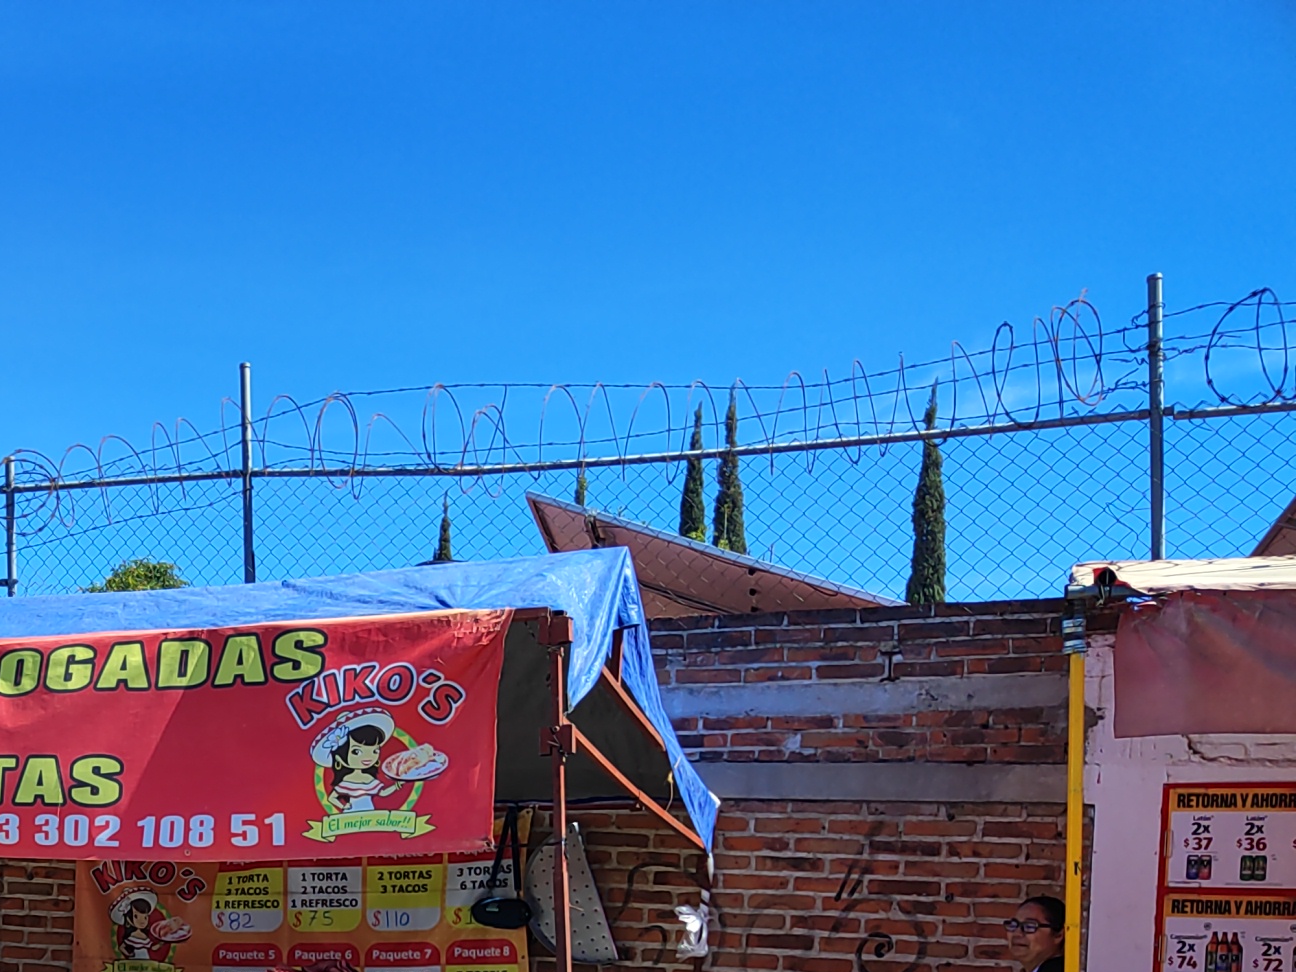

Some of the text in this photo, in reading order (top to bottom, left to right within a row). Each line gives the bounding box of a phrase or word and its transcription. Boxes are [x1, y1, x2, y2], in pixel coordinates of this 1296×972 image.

[1177, 792, 1238, 809] RETORNA
[1240, 792, 1250, 809] Y
[328, 814, 411, 832] El mejor sabor!!
[1191, 822, 1211, 836] 2x
[1244, 822, 1265, 837] 2x
[34, 813, 121, 847] 302
[137, 815, 214, 847] 108
[230, 813, 285, 846] 51
[1183, 836, 1214, 851] $37
[1236, 837, 1268, 852] $36
[301, 872, 348, 882] 1 TORTA
[377, 870, 432, 881] 2 TORTAS
[456, 868, 464, 877] 3
[228, 874, 269, 885] 1 TORTA
[460, 882, 467, 890] 6
[225, 886, 269, 896] 3 TACOS
[301, 885, 348, 895] 2 TACOS
[380, 883, 428, 894] 3 TACOS
[215, 899, 280, 909] 1 REFRESCO
[291, 898, 358, 908] 1 REFRESCO
[1171, 899, 1296, 917] RETORNA Y AHORR
[454, 945, 510, 960] Paquete 8
[1176, 940, 1196, 954] 2x
[1261, 942, 1282, 957] 2x
[218, 949, 275, 961] Paquete 5
[294, 949, 352, 961] Paquete 6
[372, 949, 432, 961] Paquete 7
[1167, 955, 1198, 970] $74
[1252, 958, 1284, 972] $72
